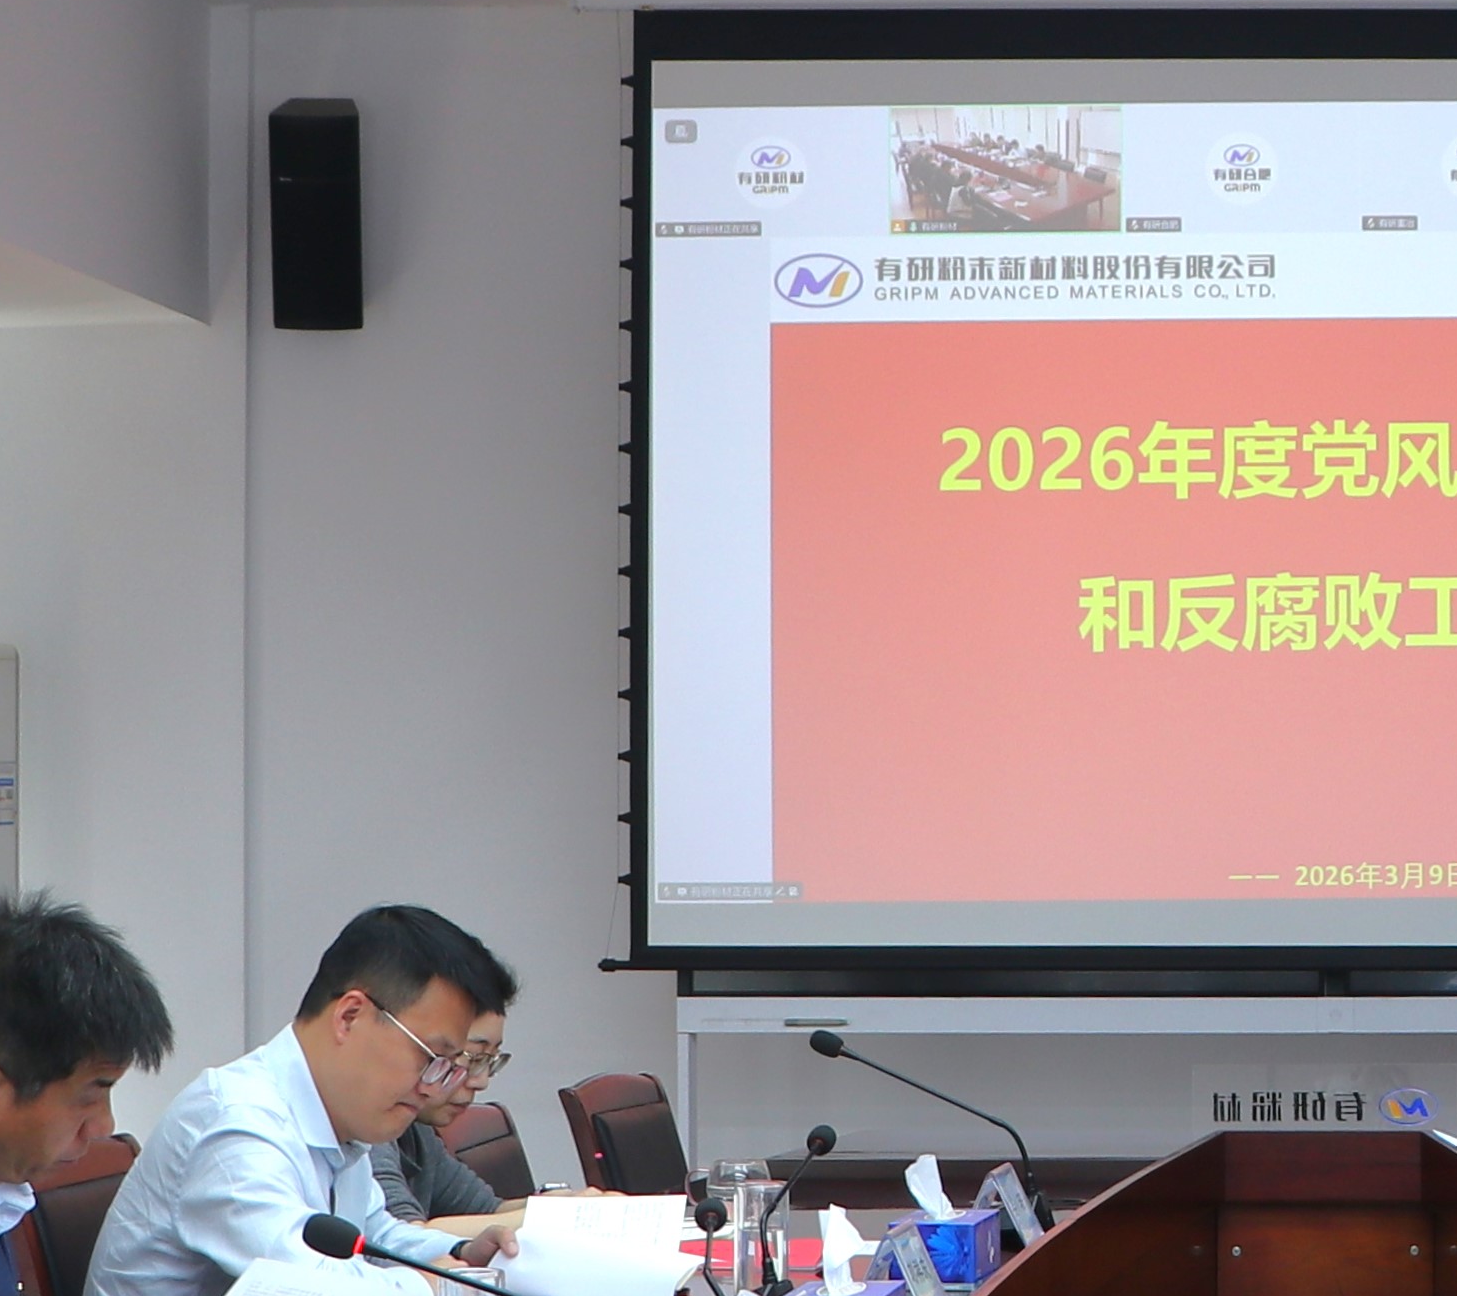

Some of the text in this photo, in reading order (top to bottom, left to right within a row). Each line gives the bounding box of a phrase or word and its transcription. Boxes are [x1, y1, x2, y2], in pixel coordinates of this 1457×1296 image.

[737, 171, 805, 185] 有研粉材
[1213, 168, 1271, 182] 有研合肥
[752, 185, 789, 194] GRIPM
[1224, 183, 1261, 192] GRIPM
[874, 254, 1276, 281] 有研粉末新材料股份有限公司
[874, 285, 939, 302] GRIPM
[950, 285, 1060, 301] ADVANCED
[1070, 284, 1183, 300] MATERIALS
[1236, 283, 1276, 299] LTD.
